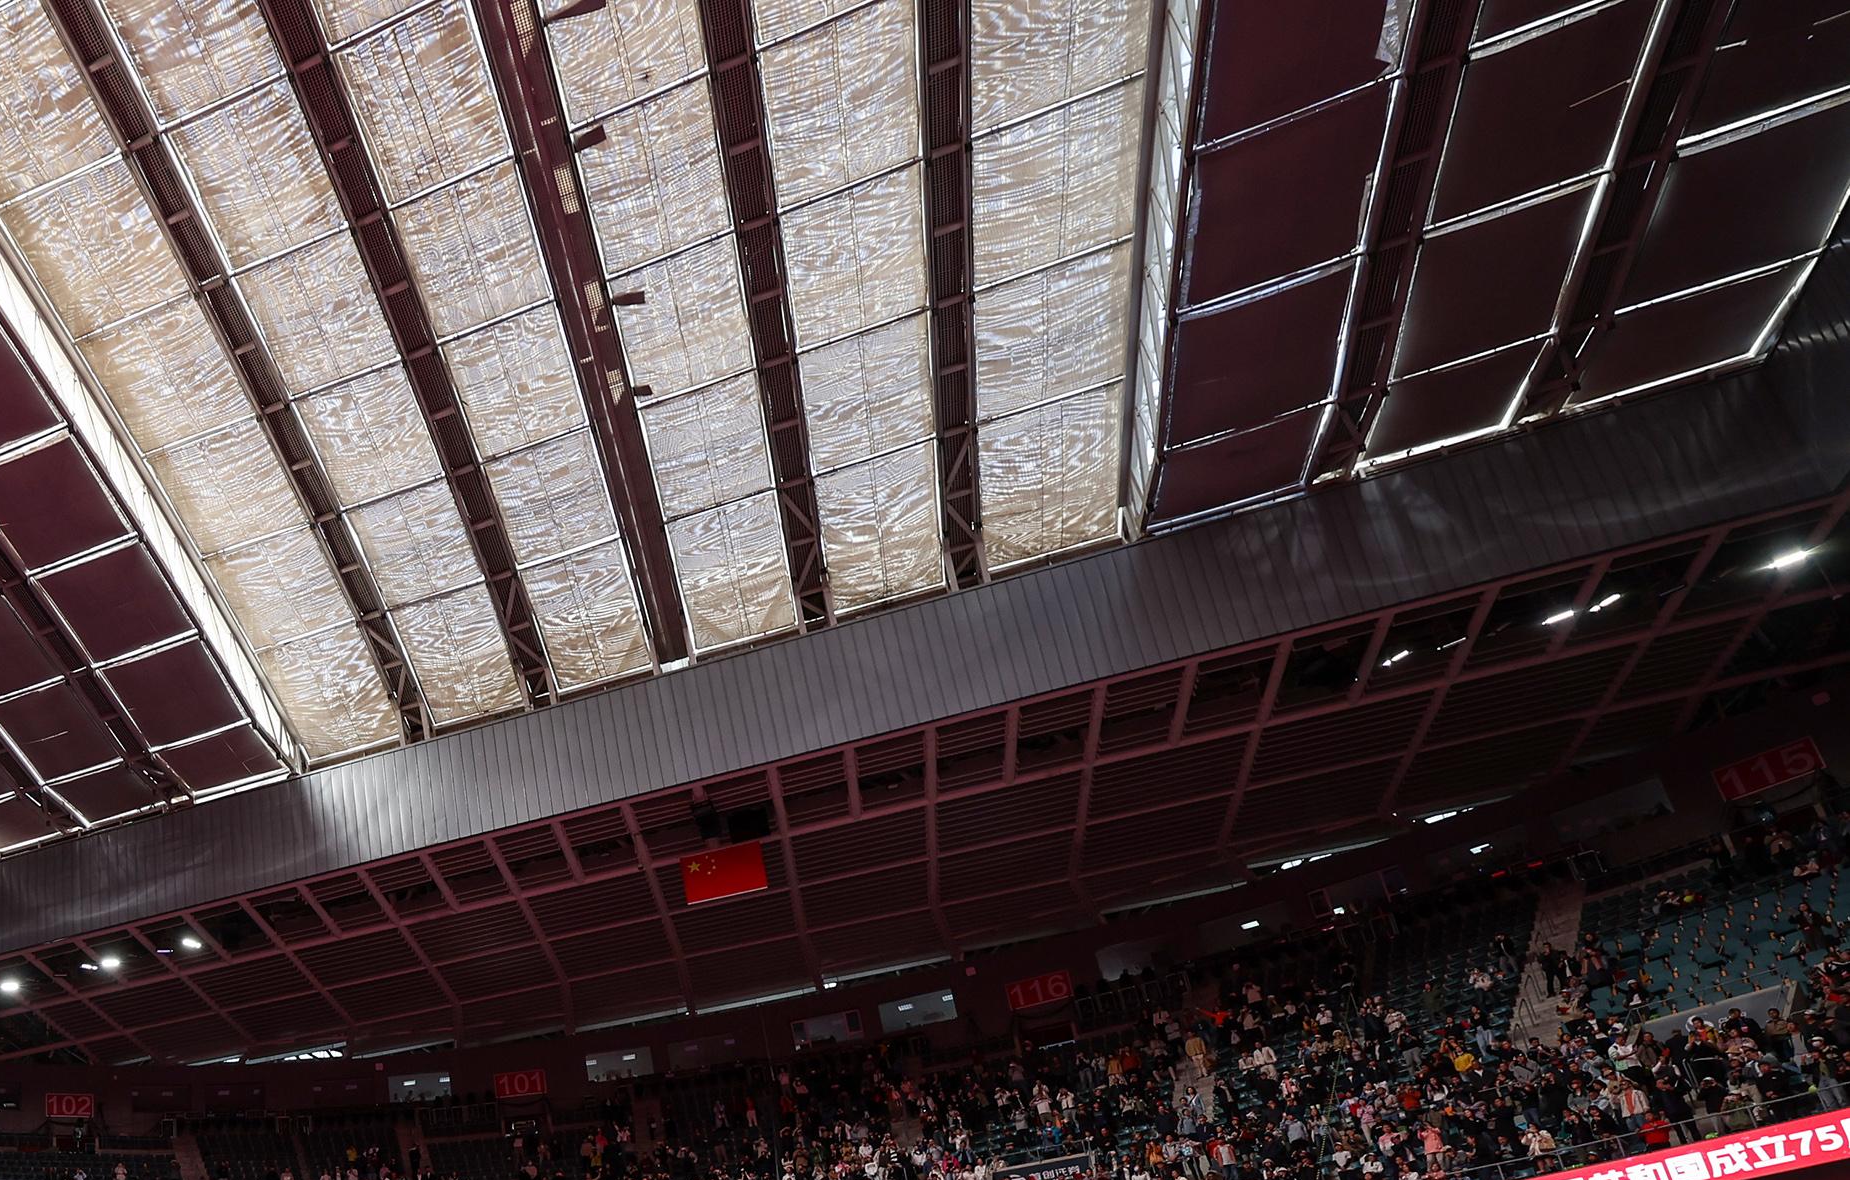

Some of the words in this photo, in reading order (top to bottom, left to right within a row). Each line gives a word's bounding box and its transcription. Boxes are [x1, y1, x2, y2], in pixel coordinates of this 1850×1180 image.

[1721, 742, 1817, 794] 115
[1009, 974, 1069, 1006] 116
[499, 1074, 543, 1094] 101
[48, 1094, 92, 1117] 102
